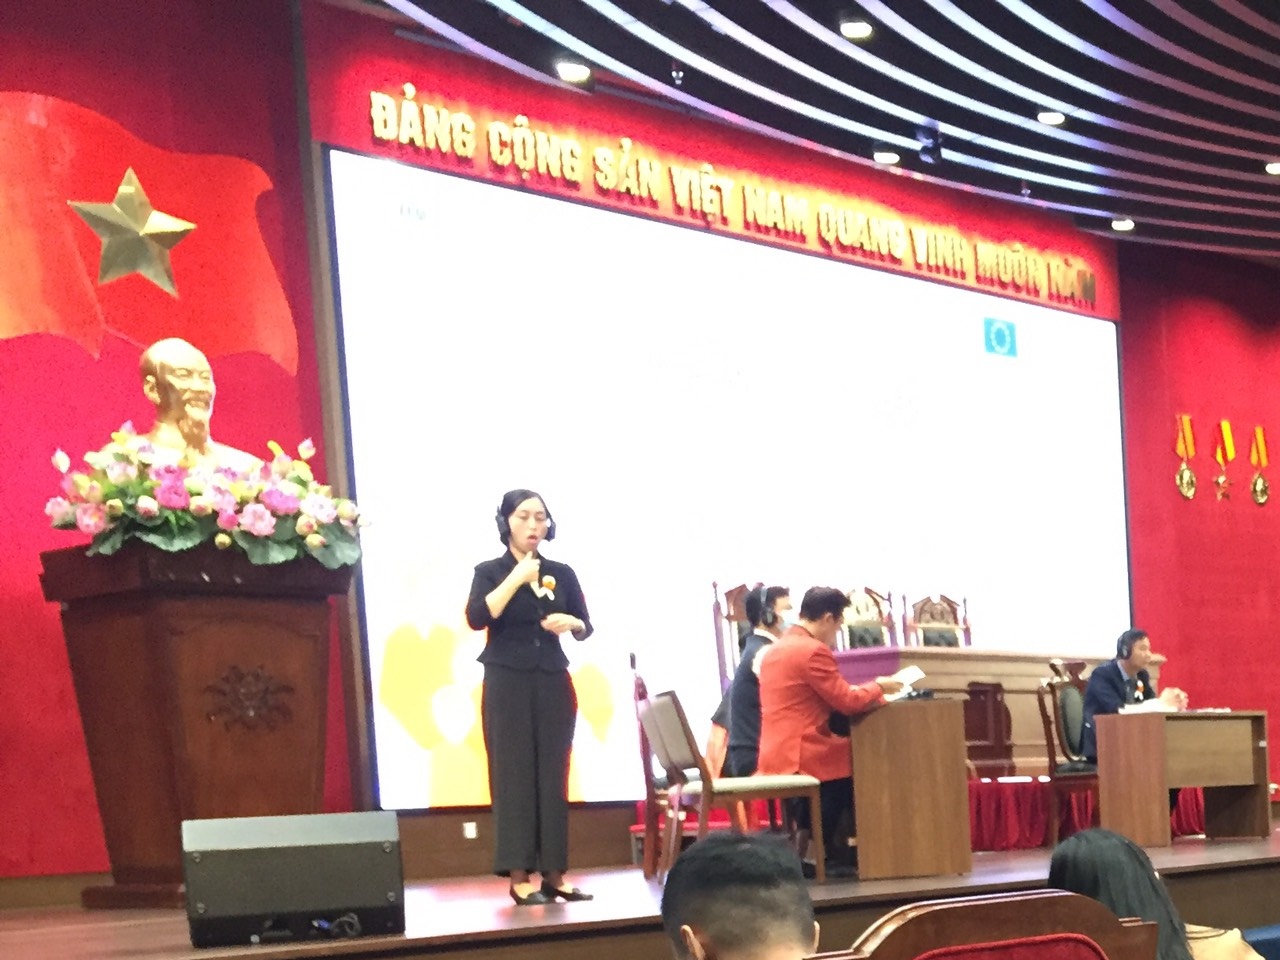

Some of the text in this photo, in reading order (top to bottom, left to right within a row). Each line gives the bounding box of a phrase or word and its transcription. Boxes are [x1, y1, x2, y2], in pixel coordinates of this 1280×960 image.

[370, 82, 476, 159] ĐẢNG
[487, 114, 582, 183] CỘNG
[592, 137, 662, 204] SẢN
[669, 162, 735, 223] VIỆT
[743, 182, 808, 240] NAM
[816, 200, 906, 262] QUANG
[909, 225, 968, 278] VINH
